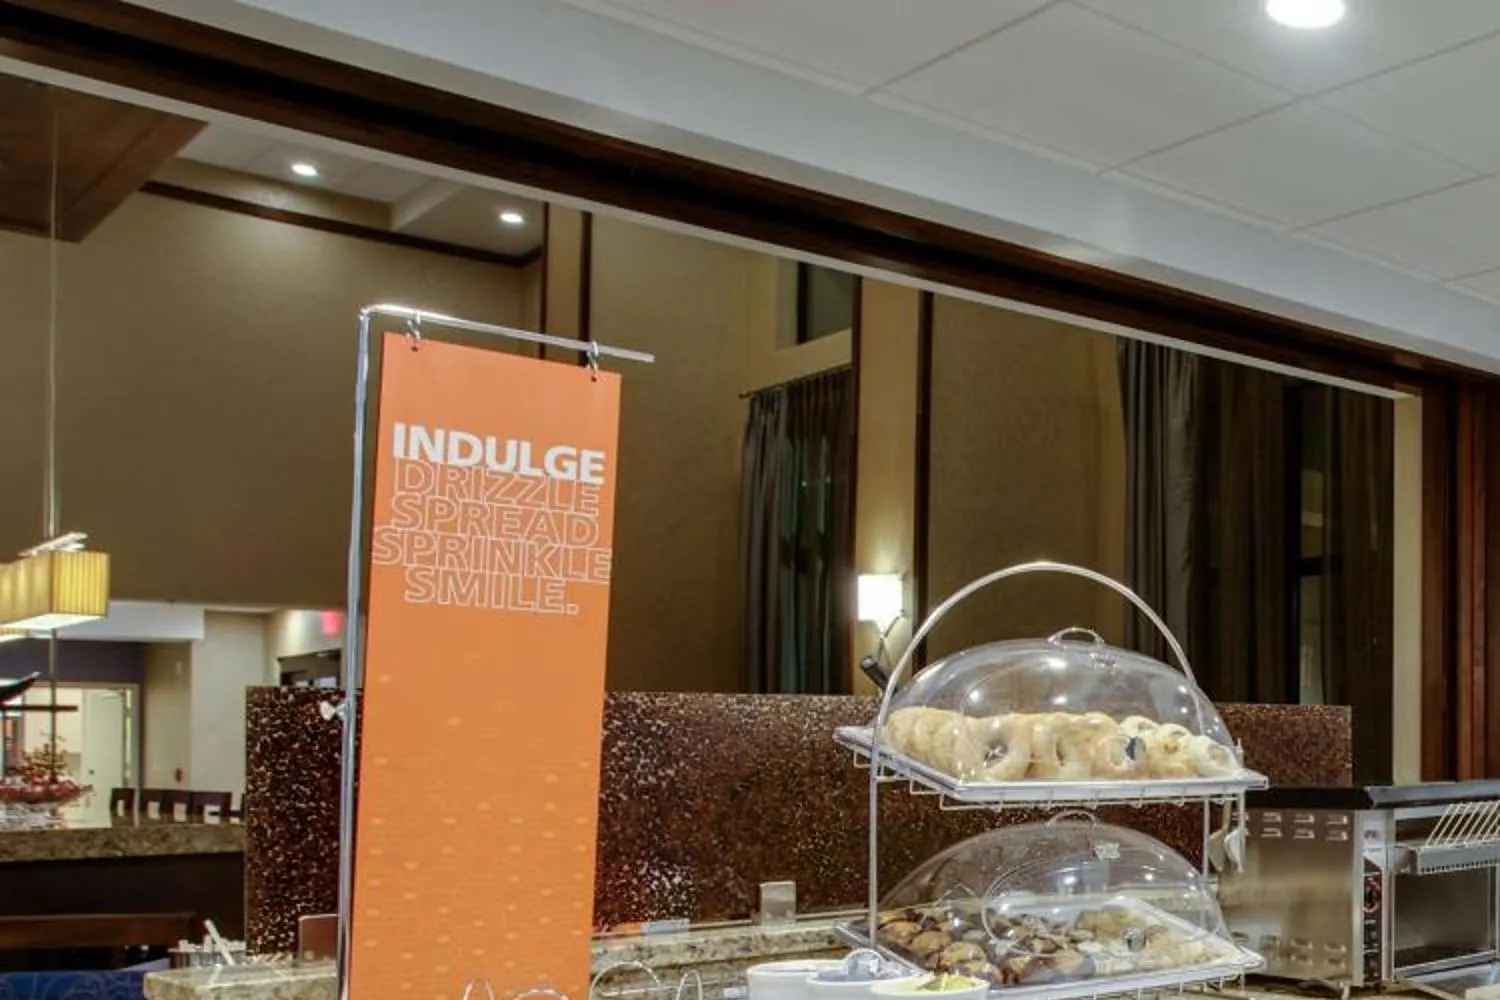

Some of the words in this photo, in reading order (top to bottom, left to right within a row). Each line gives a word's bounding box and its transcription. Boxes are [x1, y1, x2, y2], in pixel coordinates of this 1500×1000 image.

[392, 422, 606, 485] INDULGE
[395, 458, 600, 518] DRIZZLE
[391, 490, 601, 548] SPREAD
[371, 523, 613, 585] SPRINKLE
[404, 565, 580, 616] SMILE.
